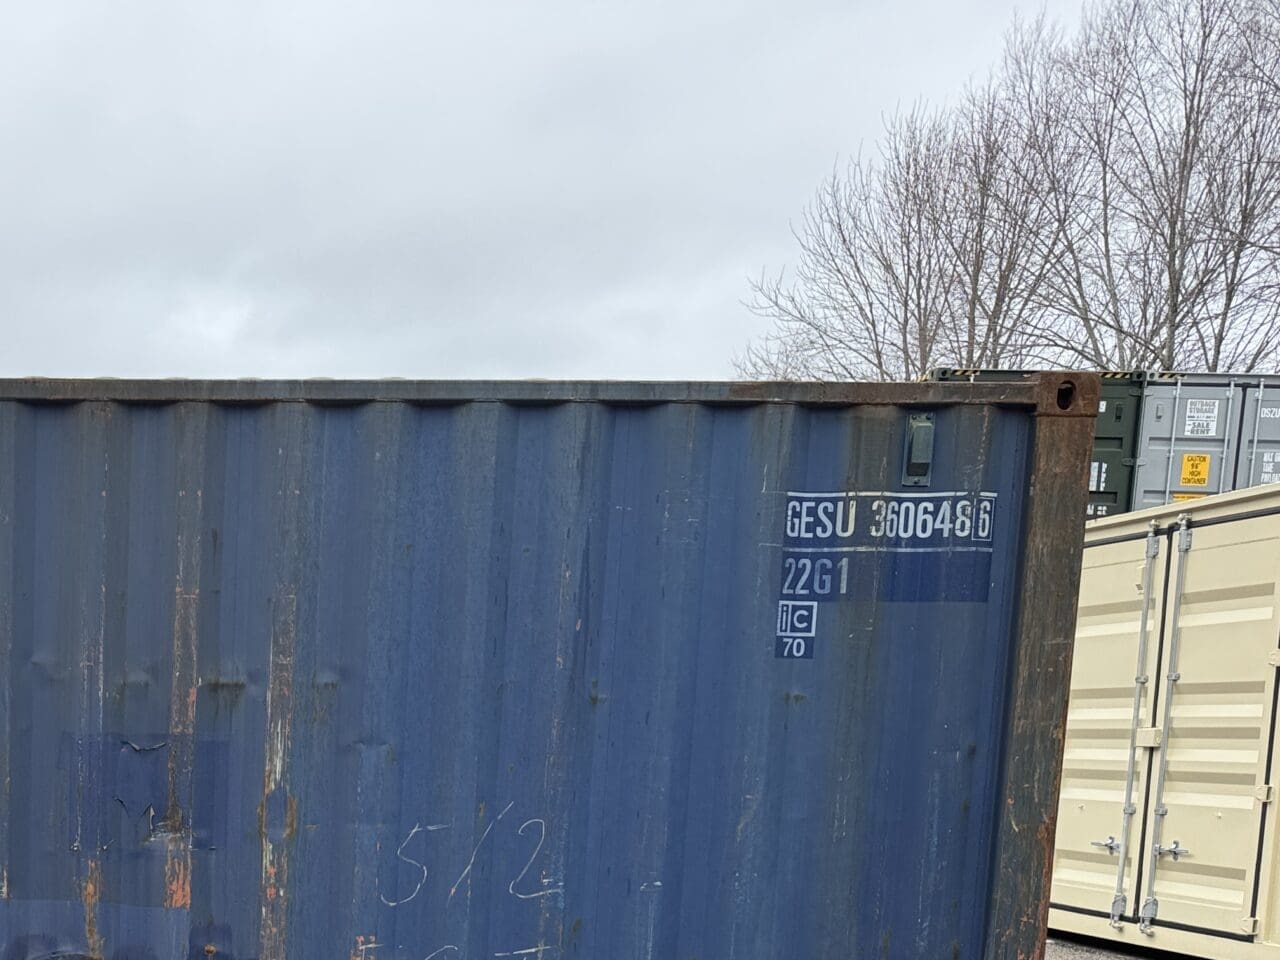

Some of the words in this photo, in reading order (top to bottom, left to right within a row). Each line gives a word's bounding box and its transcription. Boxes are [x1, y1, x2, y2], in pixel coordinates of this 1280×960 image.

[786, 500, 856, 538] GESU
[782, 557, 849, 594] 22G1
[782, 638, 806, 657] 70
